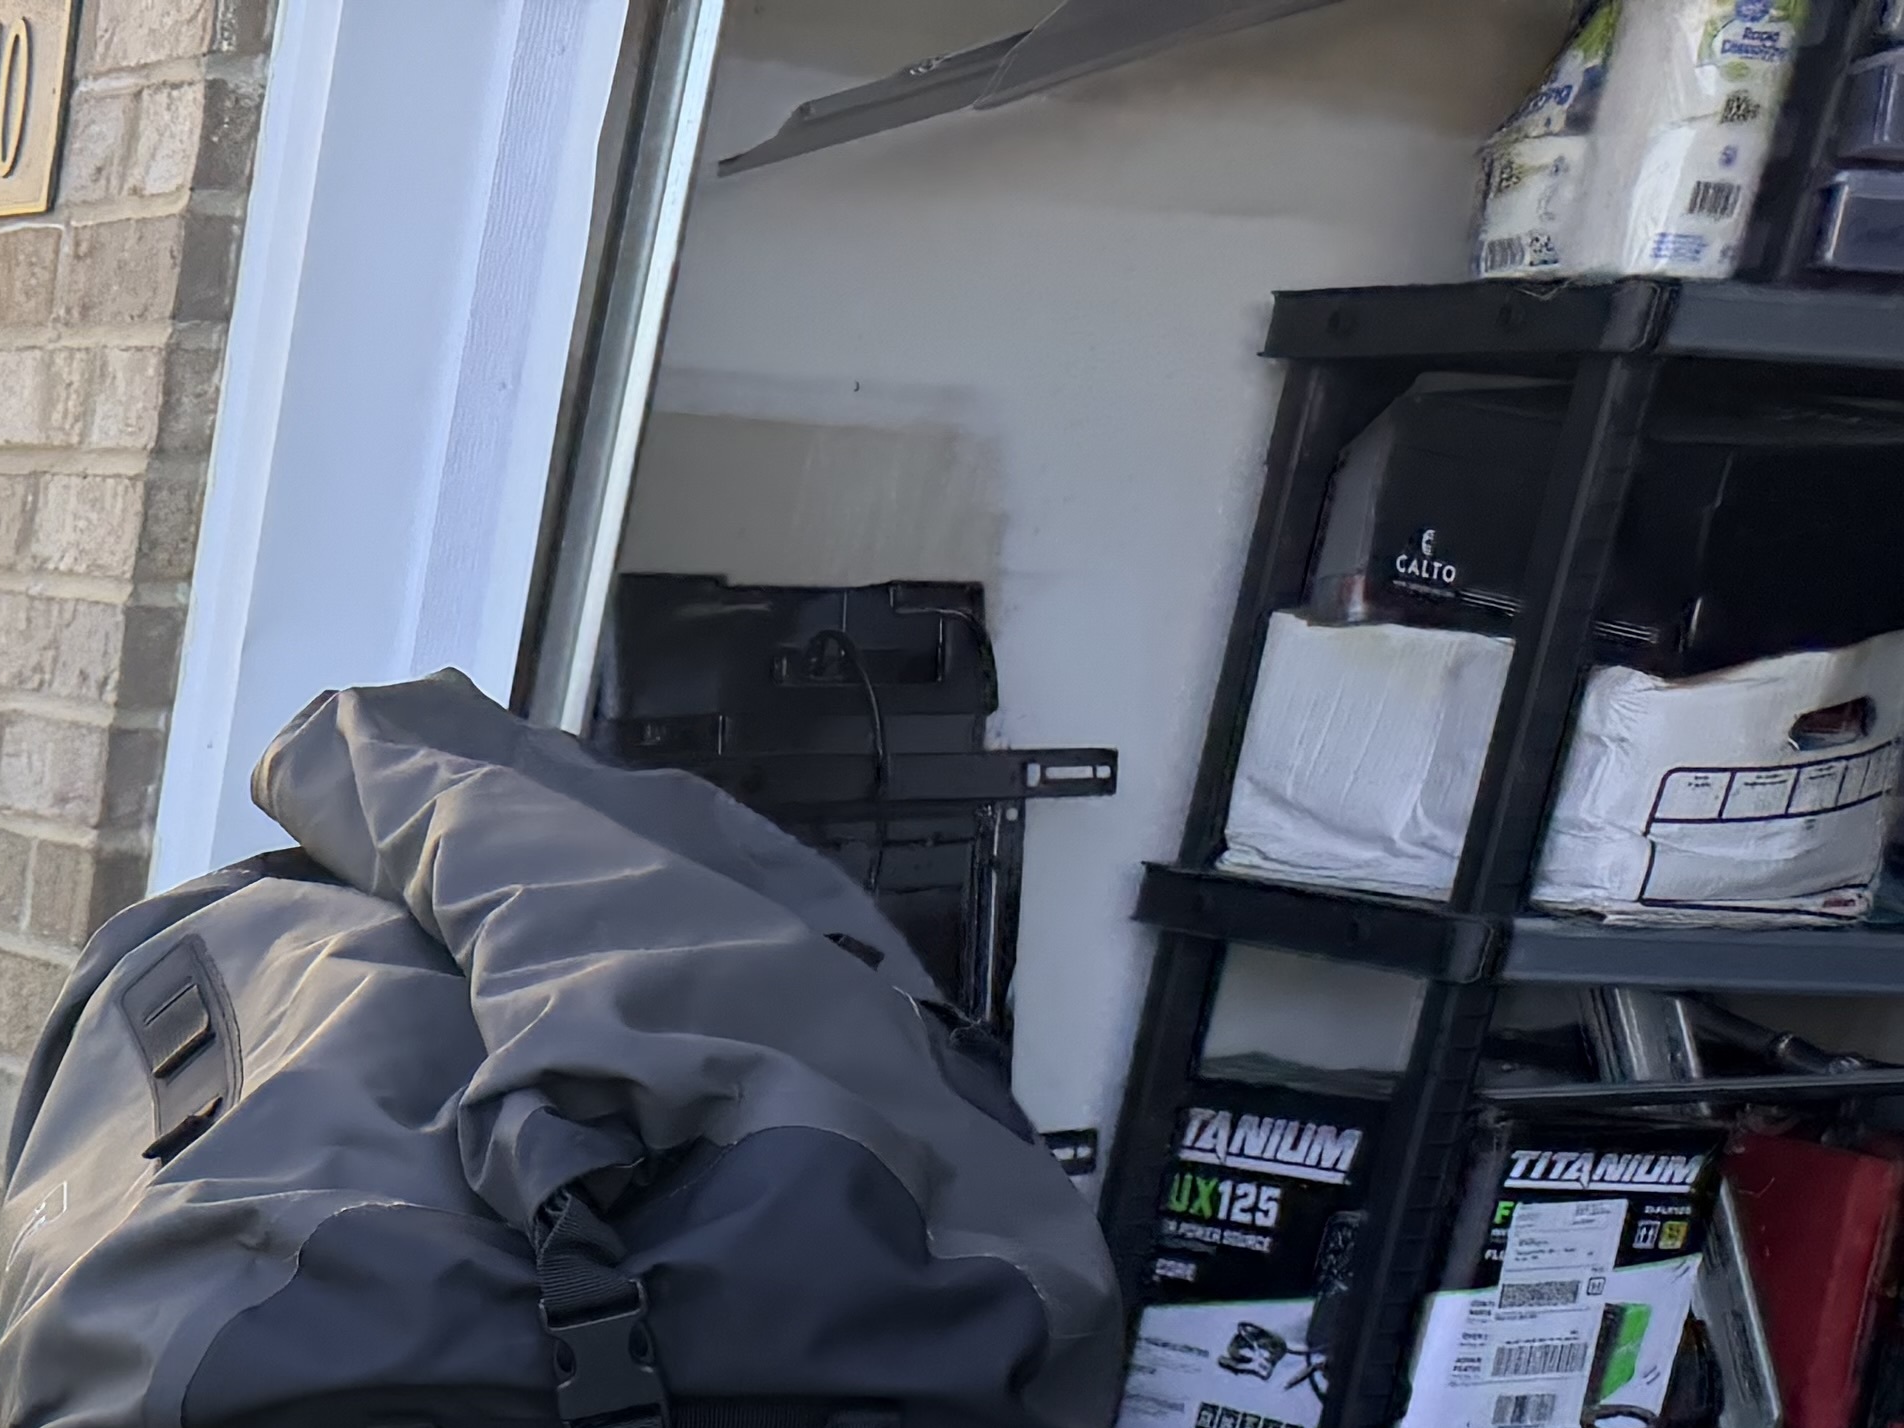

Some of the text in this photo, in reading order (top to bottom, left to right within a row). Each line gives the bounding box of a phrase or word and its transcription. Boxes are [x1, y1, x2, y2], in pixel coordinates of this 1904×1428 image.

[1396, 554, 1456, 583] CALTO
[1182, 1107, 1363, 1173] TANIUM
[1508, 1150, 1705, 1189] TITANIUM
[1167, 1172, 1282, 1229] UX125
